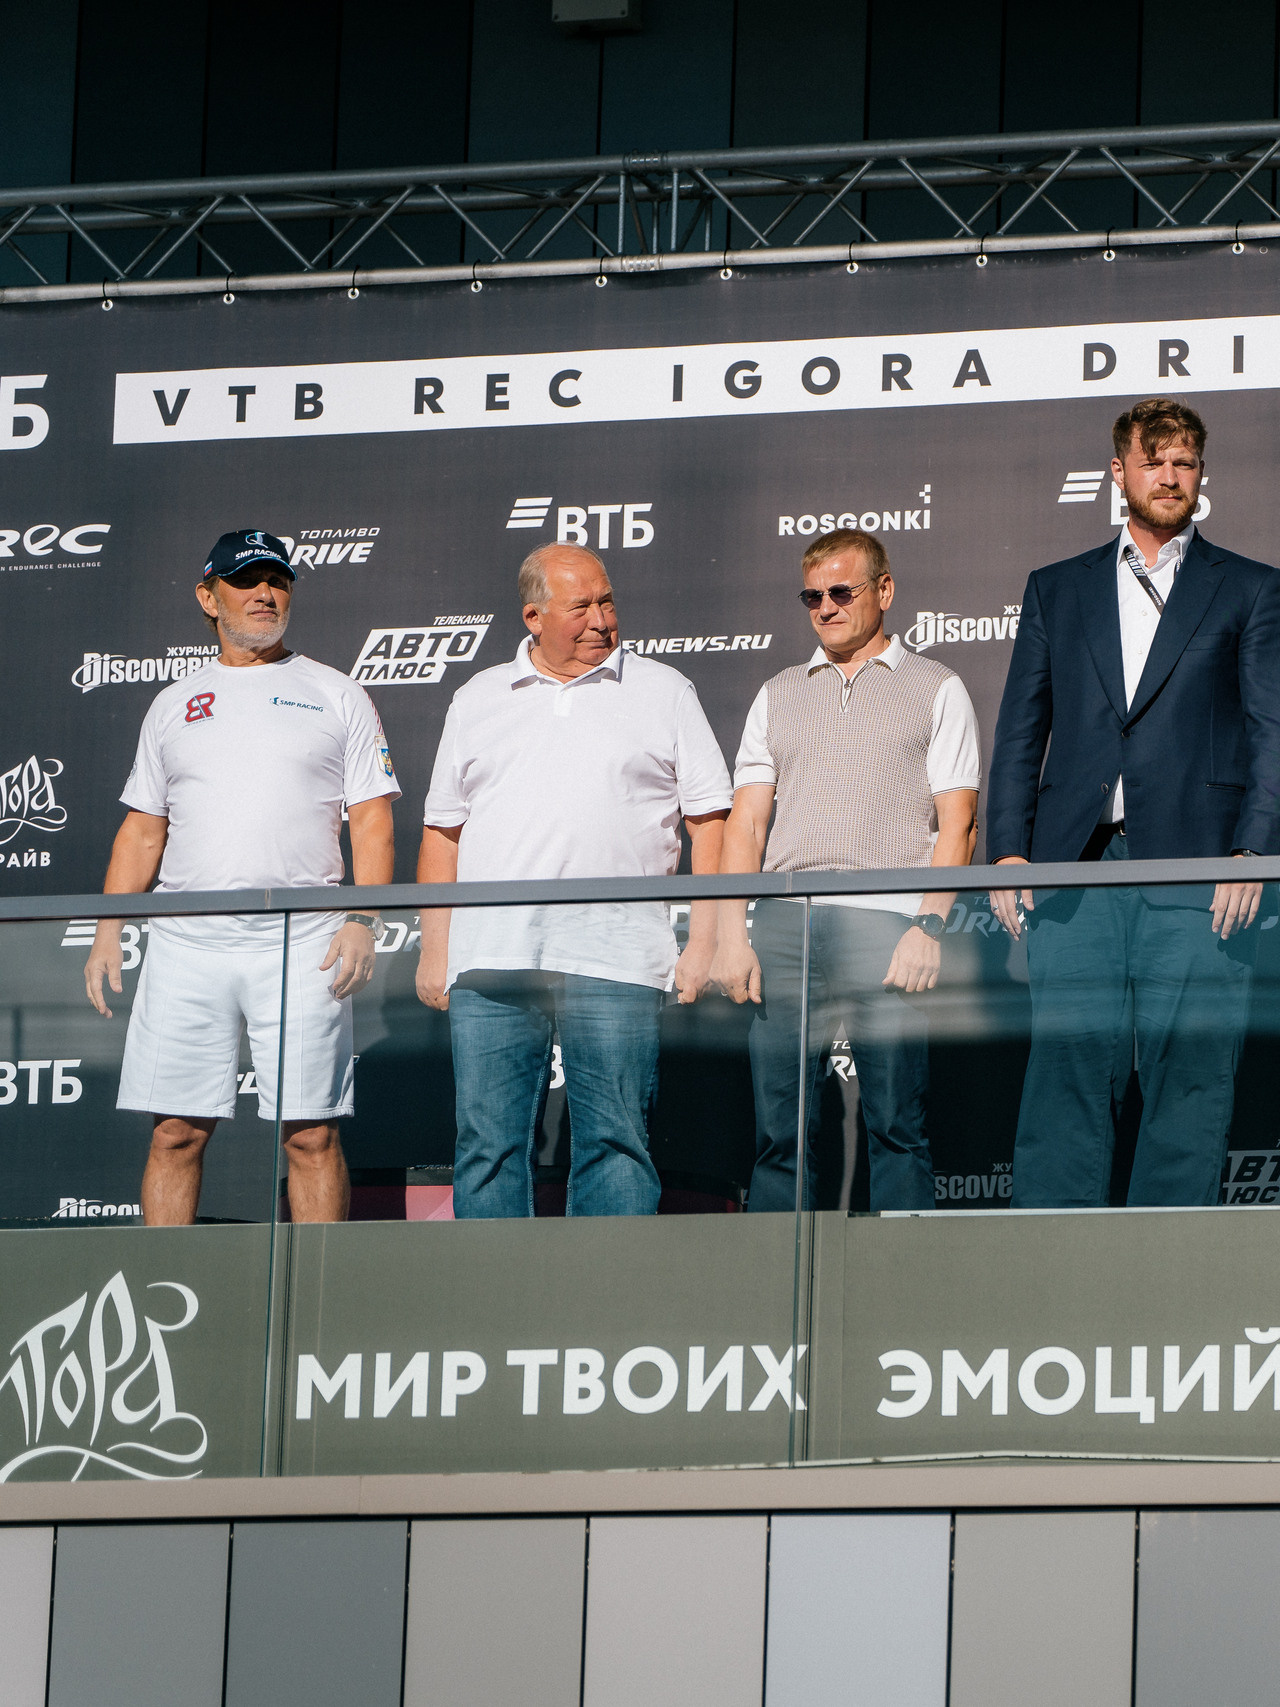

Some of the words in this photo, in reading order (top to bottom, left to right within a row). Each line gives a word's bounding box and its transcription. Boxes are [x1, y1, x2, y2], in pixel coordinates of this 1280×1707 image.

[153, 383, 324, 426] VTB
[414, 369, 582, 415] REC
[673, 349, 991, 402] IGORA
[557, 503, 655, 549] ВТБ
[778, 509, 931, 536] ROSGONKI
[300, 527, 381, 540] ТОПЛИВО
[235, 550, 253, 560] SMP
[433, 614, 495, 626] ТЕЛЕКАНАЛ
[166, 645, 219, 657] ЖУРНАЛ
[363, 631, 477, 660] АВТО
[355, 662, 436, 681] ПЛЮС
[280, 699, 296, 707] SMP
[295, 1350, 487, 1420] МИР
[506, 1344, 809, 1415] ТВОИХ
